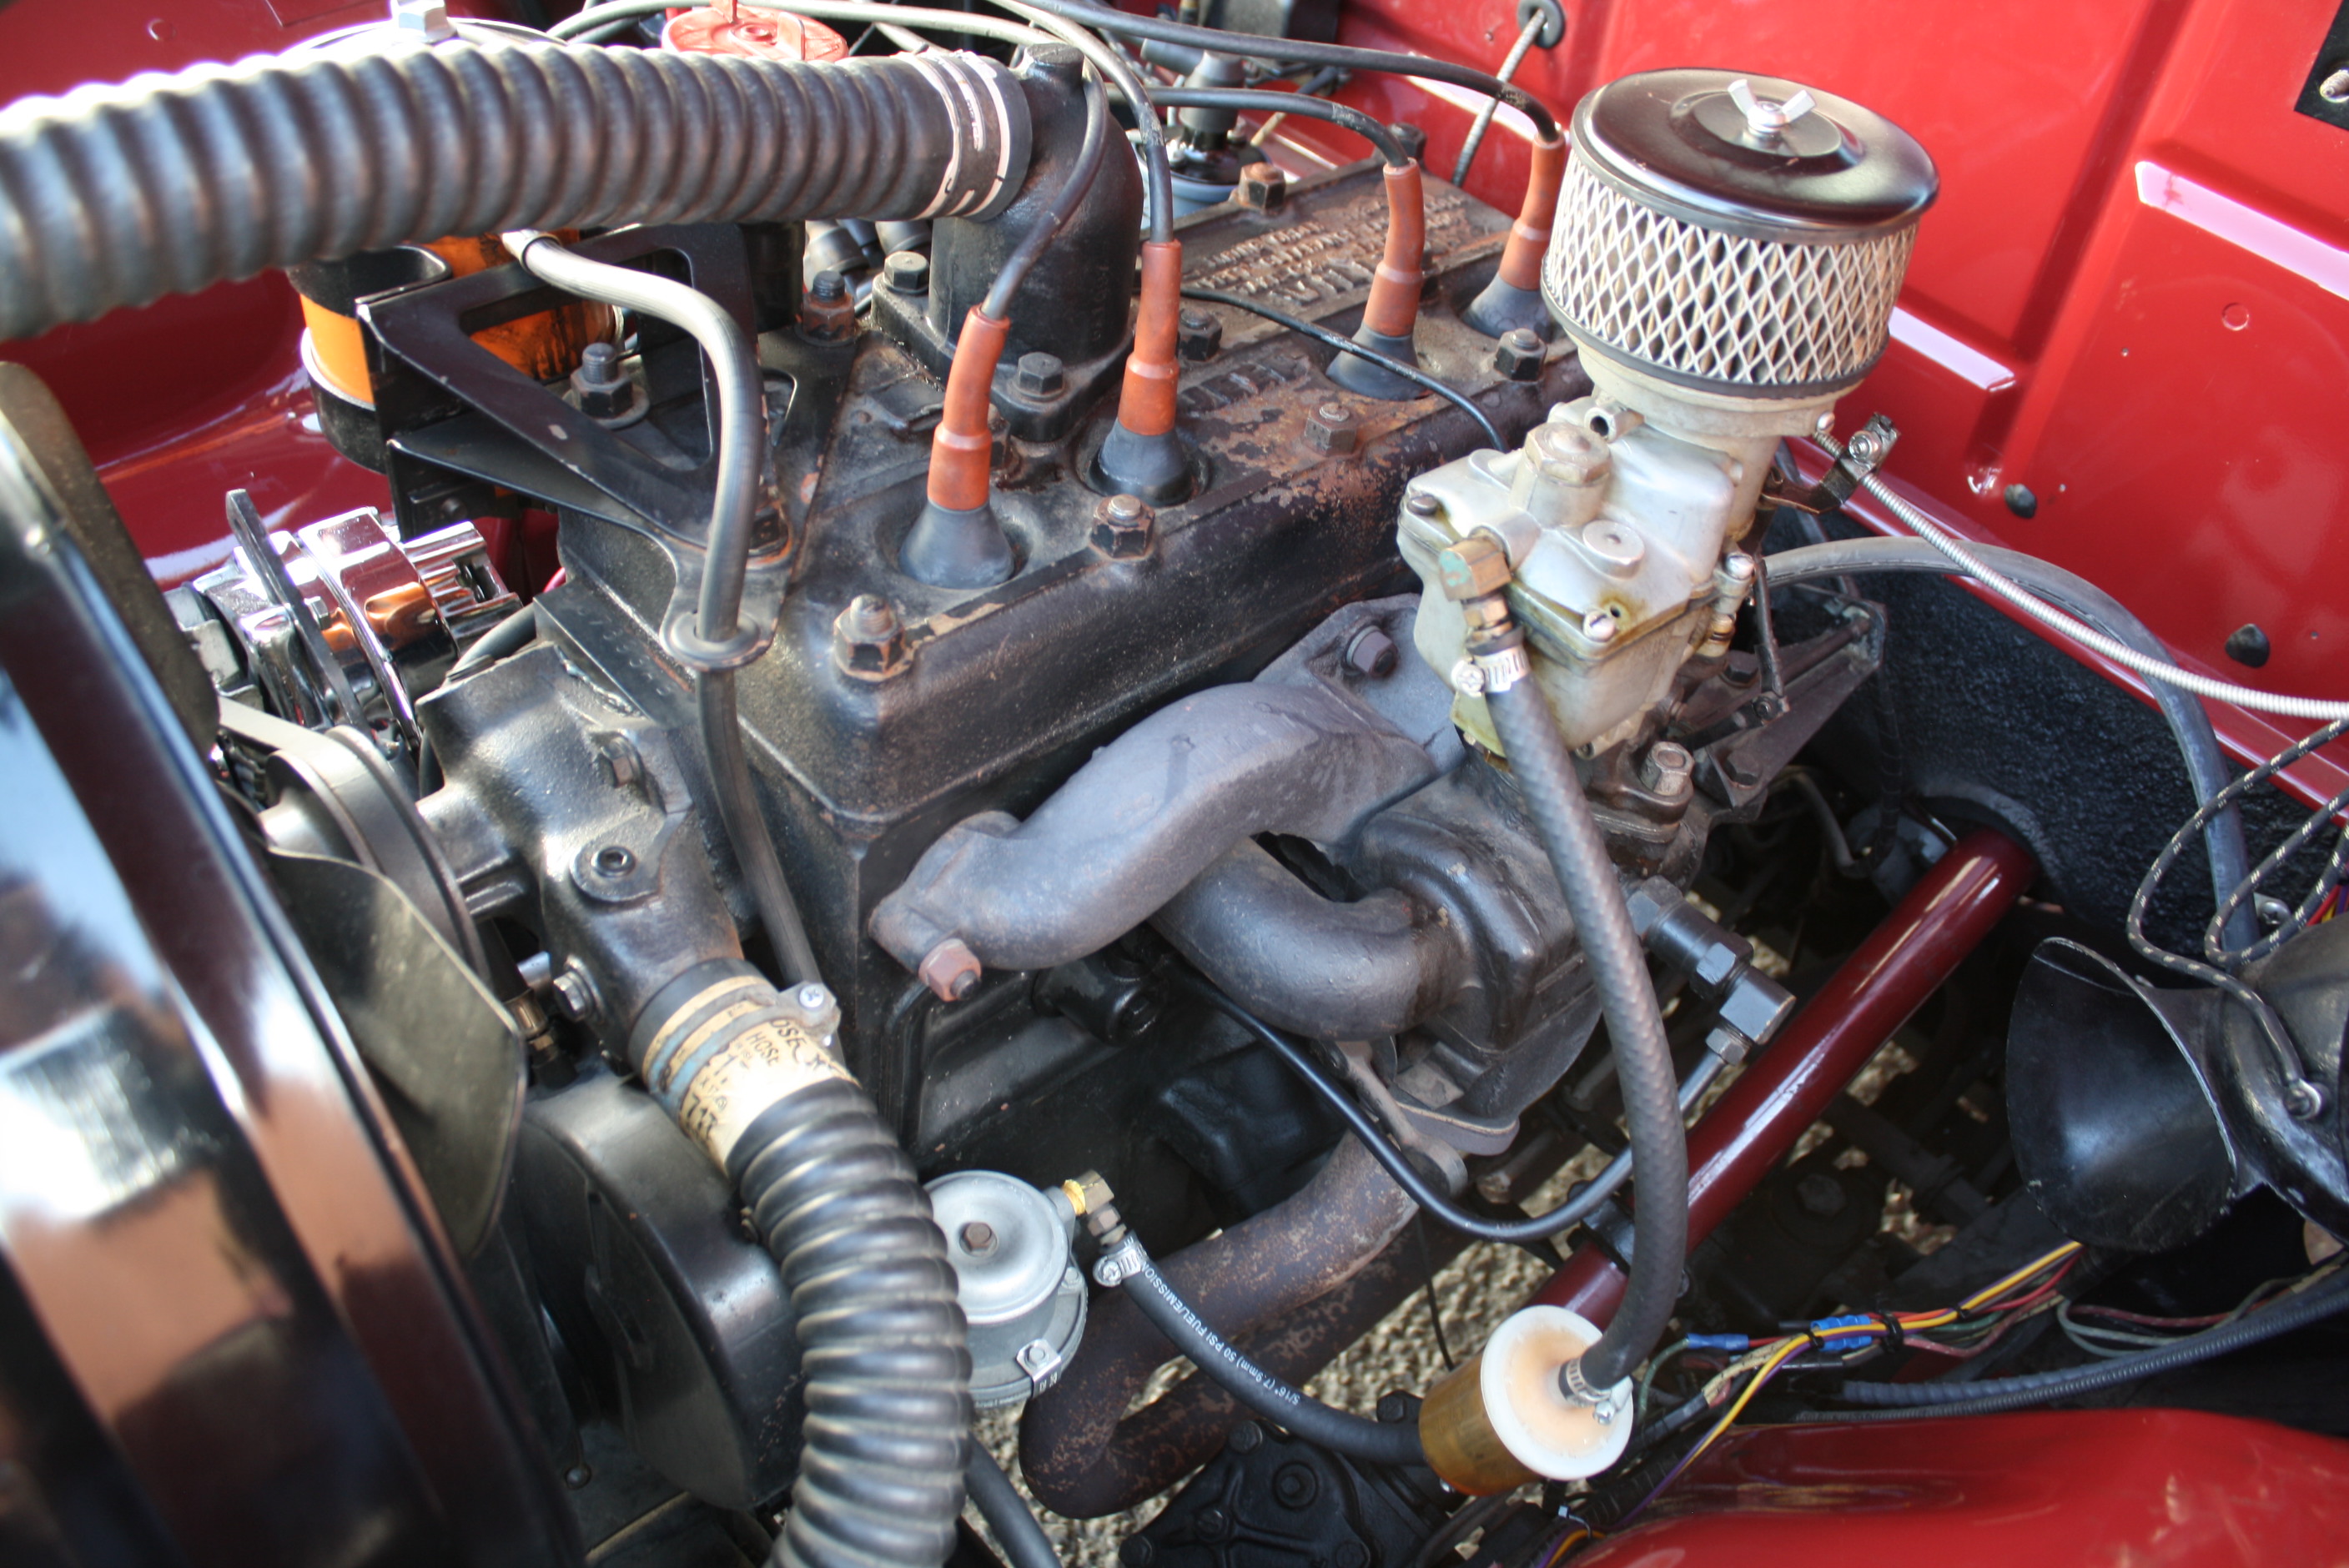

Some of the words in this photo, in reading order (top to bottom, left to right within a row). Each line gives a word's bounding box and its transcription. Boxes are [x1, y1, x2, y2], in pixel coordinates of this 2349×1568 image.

[1206, 1332, 1224, 1353] PSI
[1223, 1347, 1237, 1362] 50
[1236, 1355, 1275, 1390] (7.9mm)
